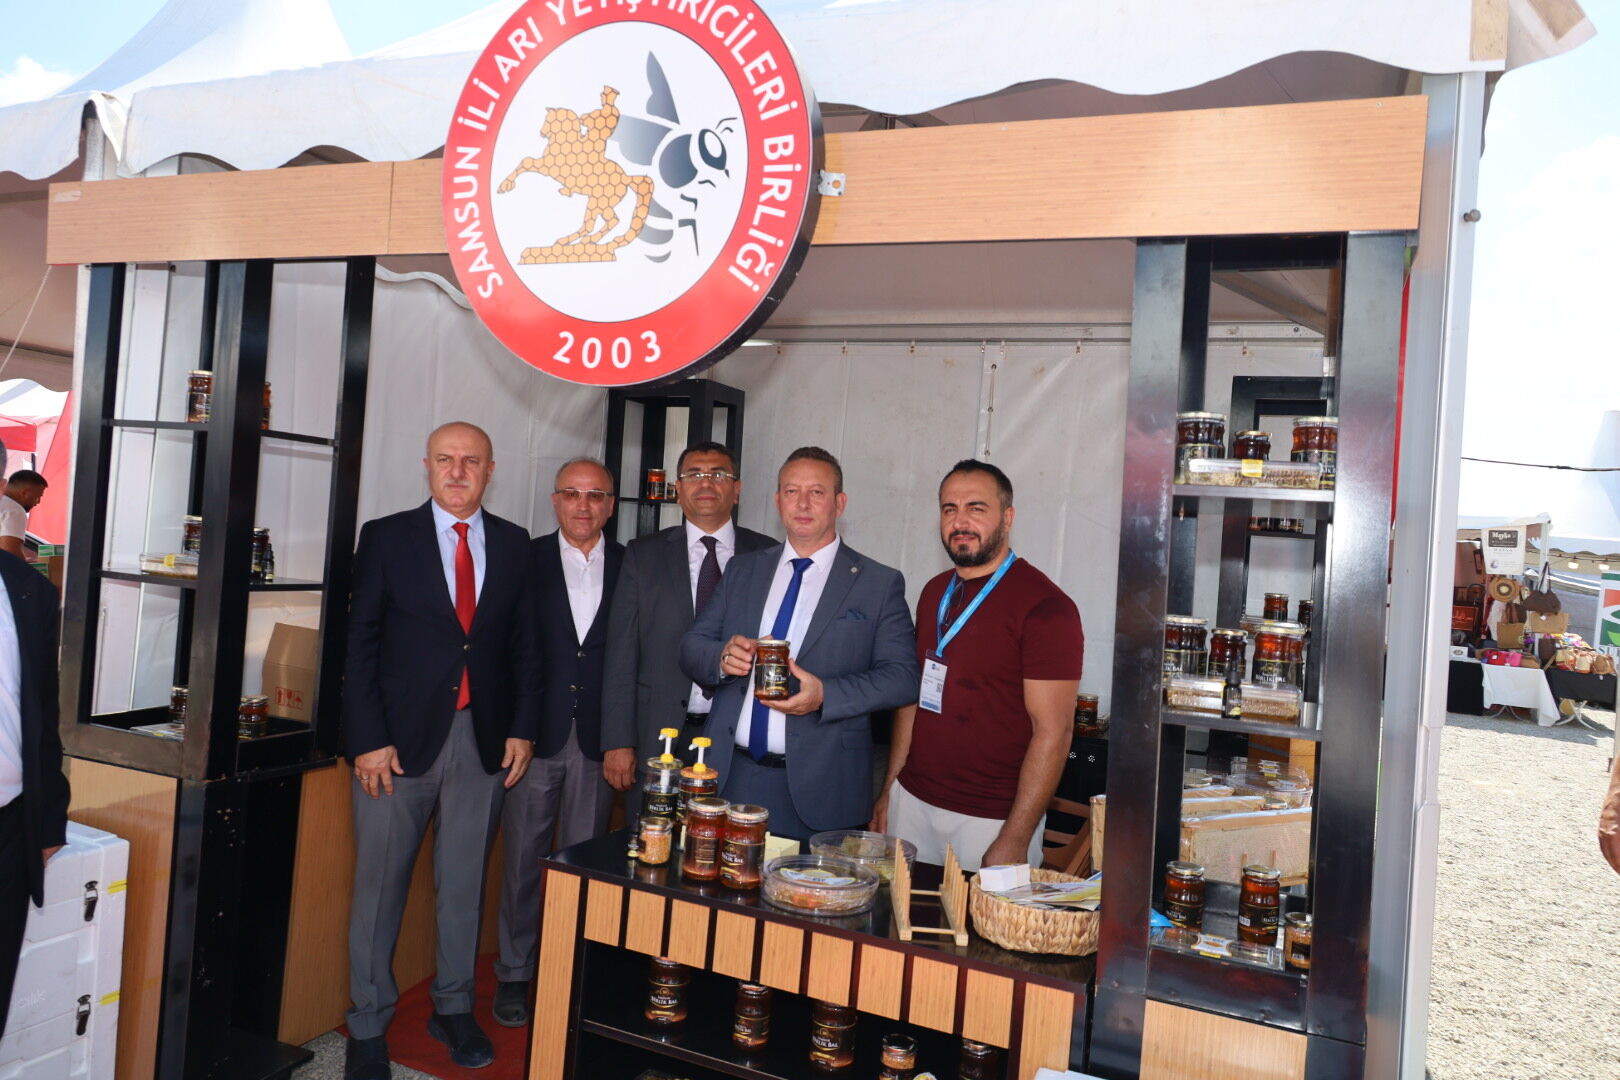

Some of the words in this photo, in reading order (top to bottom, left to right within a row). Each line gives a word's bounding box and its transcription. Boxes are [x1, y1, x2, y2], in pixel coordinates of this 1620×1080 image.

[493, 17, 544, 83] ARI
[457, 77, 500, 132] İLİ
[454, 146, 504, 299] SAMSUN
[727, 133, 803, 293] BİRLİĞİ
[552, 330, 662, 369] 2003
